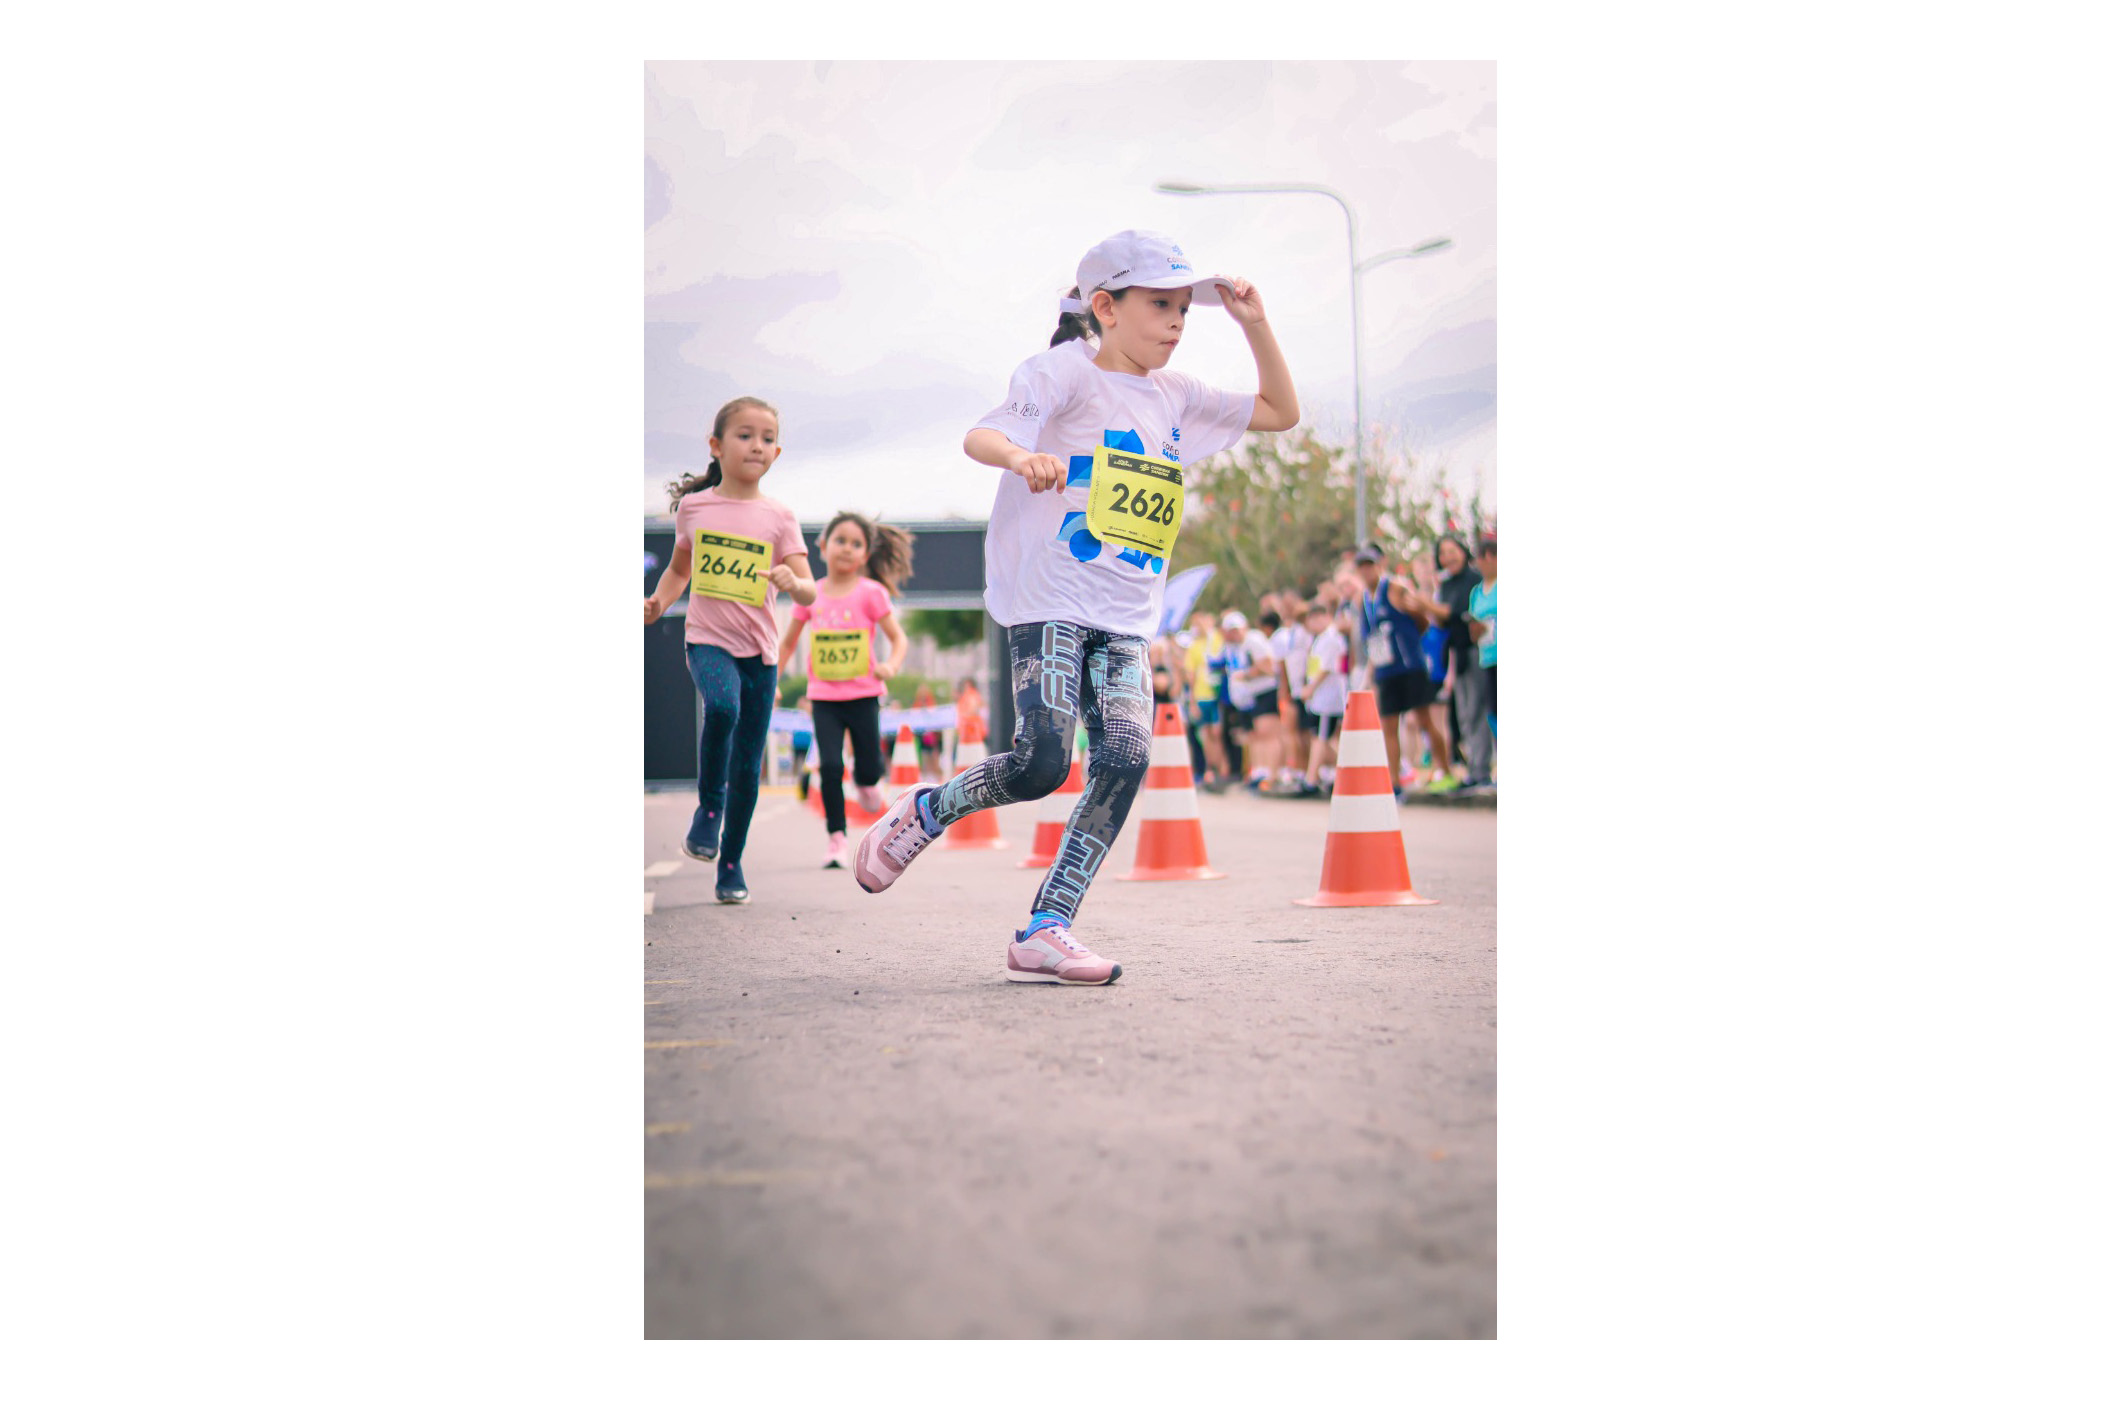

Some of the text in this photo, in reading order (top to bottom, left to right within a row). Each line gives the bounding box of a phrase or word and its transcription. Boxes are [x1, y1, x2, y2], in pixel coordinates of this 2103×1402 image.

[1108, 483, 1176, 526] 2626
[699, 554, 757, 583] 2644
[818, 647, 859, 664] 2637
